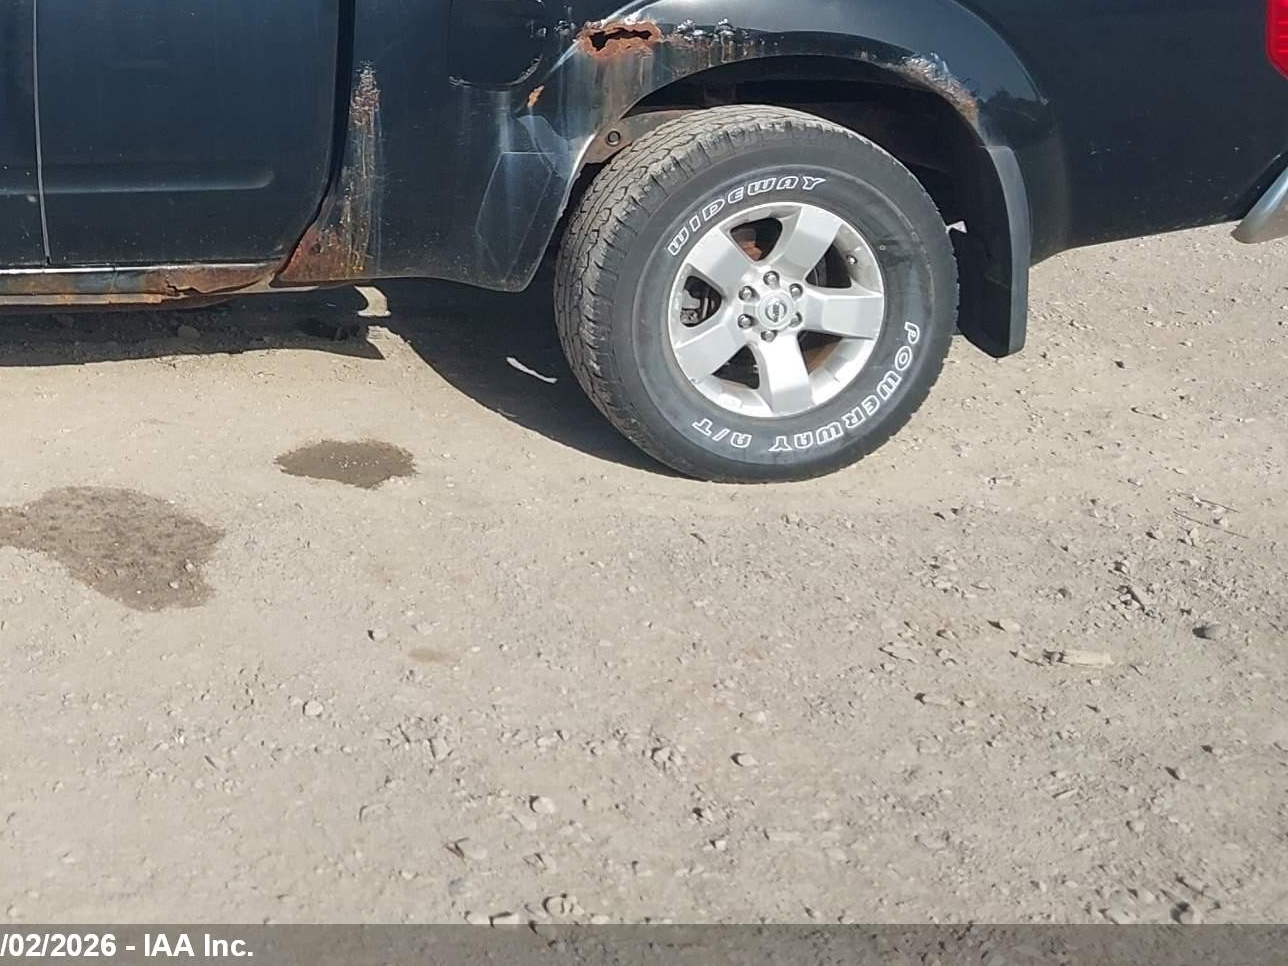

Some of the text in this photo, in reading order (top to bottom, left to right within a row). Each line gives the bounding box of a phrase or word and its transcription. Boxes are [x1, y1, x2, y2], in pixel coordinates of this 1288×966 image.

[667, 176, 826, 256] WIDEWAY
[692, 322, 920, 452] POWERWAY A/T
